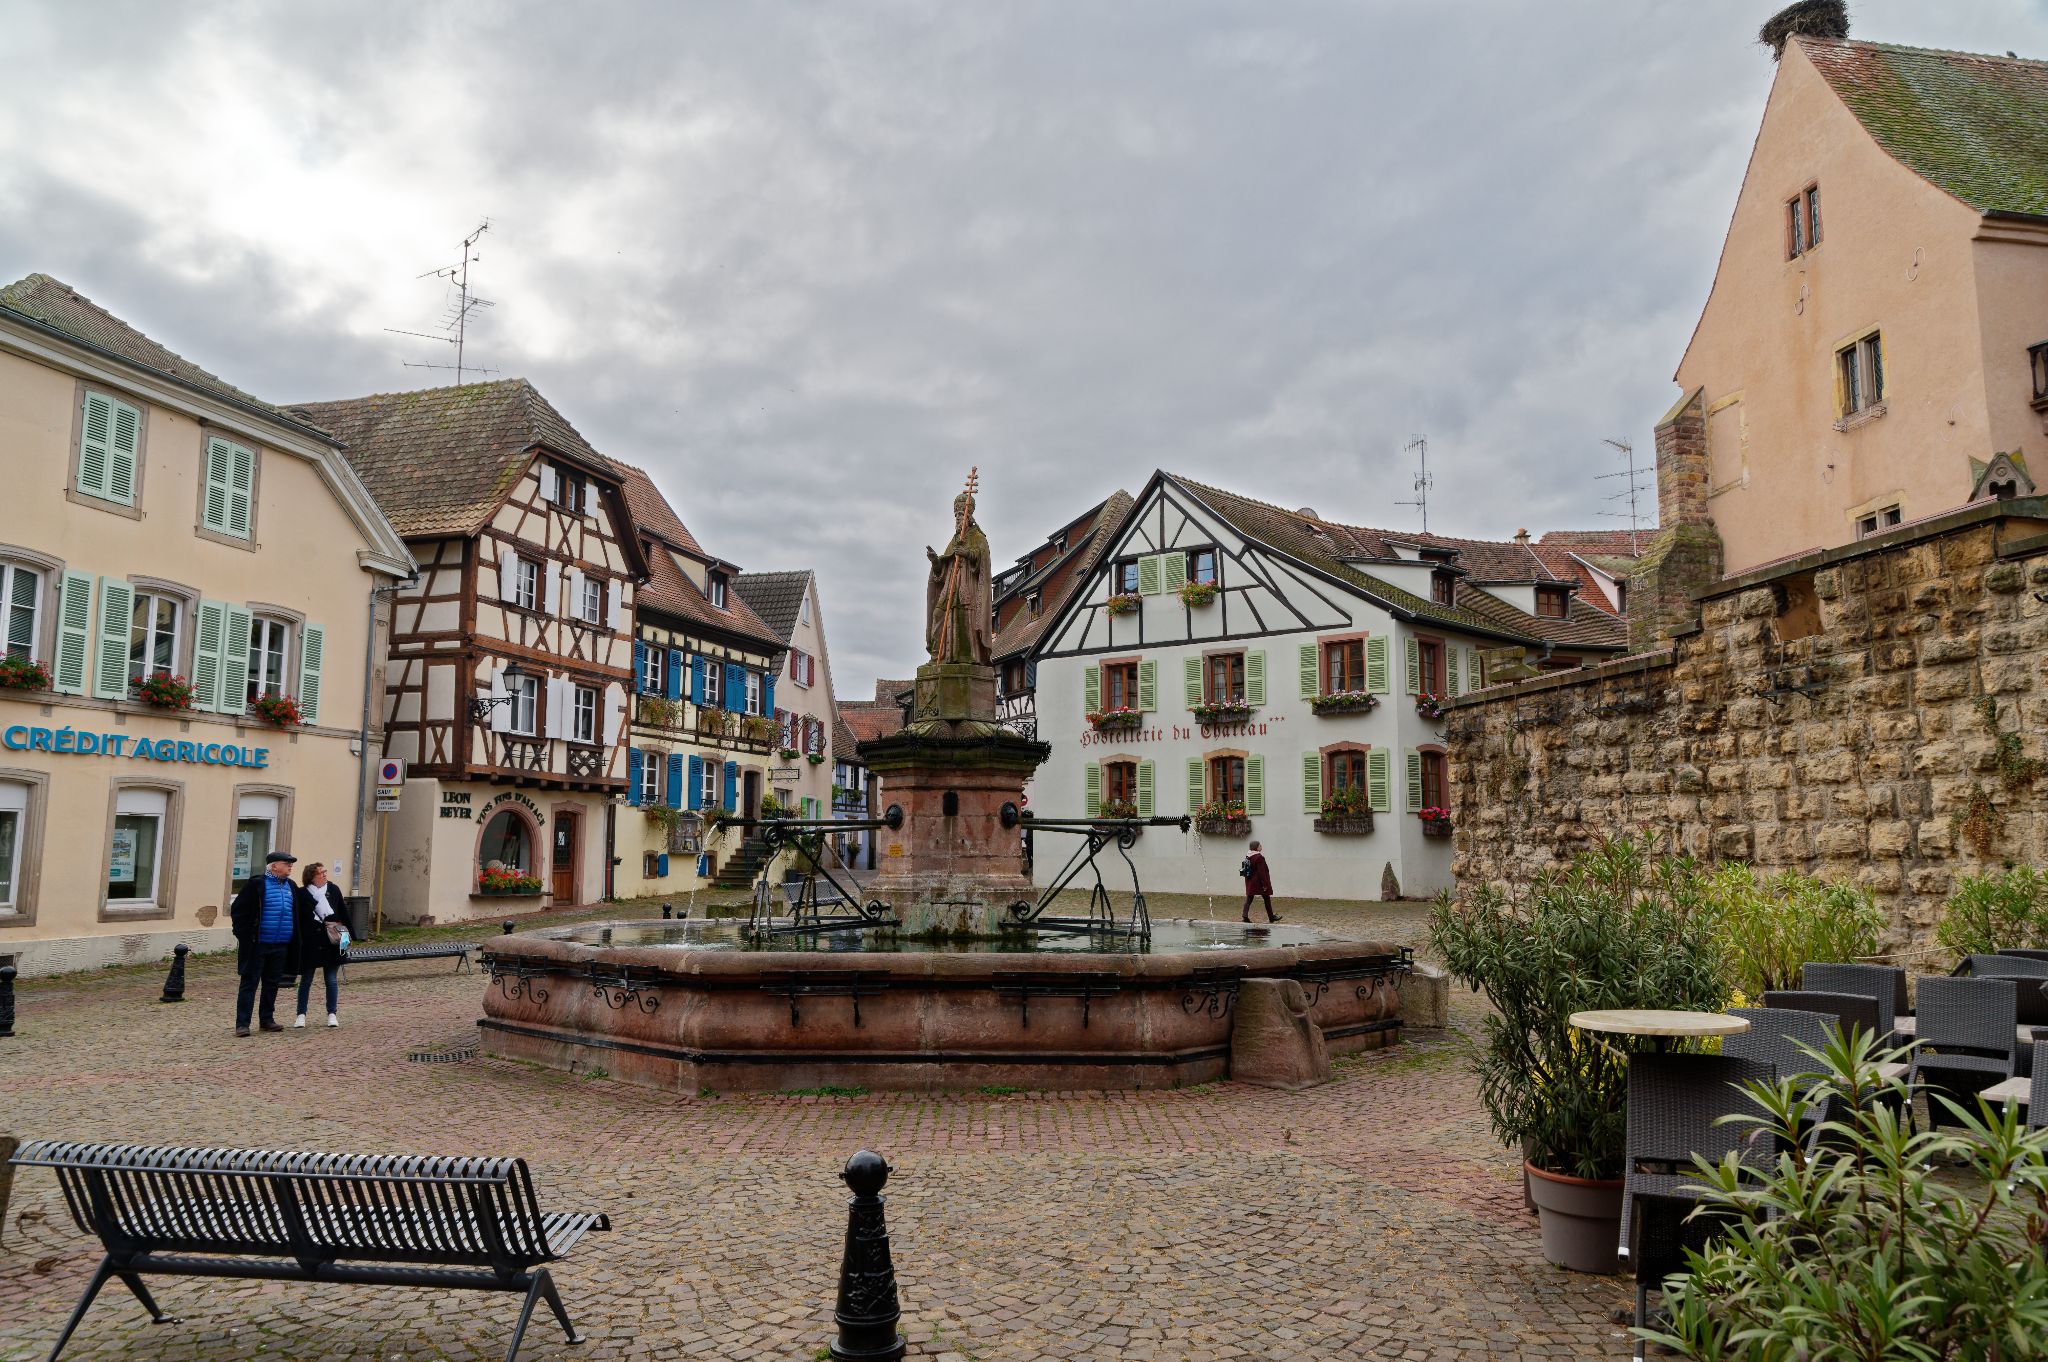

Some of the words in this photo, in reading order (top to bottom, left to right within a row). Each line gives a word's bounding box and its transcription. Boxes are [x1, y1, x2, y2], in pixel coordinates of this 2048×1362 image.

[1173, 725, 1190, 740] du
[2, 725, 129, 758] CRÉDIT
[130, 737, 269, 768] AGRICOLE
[442, 792, 472, 804] LEON
[440, 806, 472, 819] BEYER
[476, 801, 493, 824] VINS
[494, 792, 512, 805] FINS
